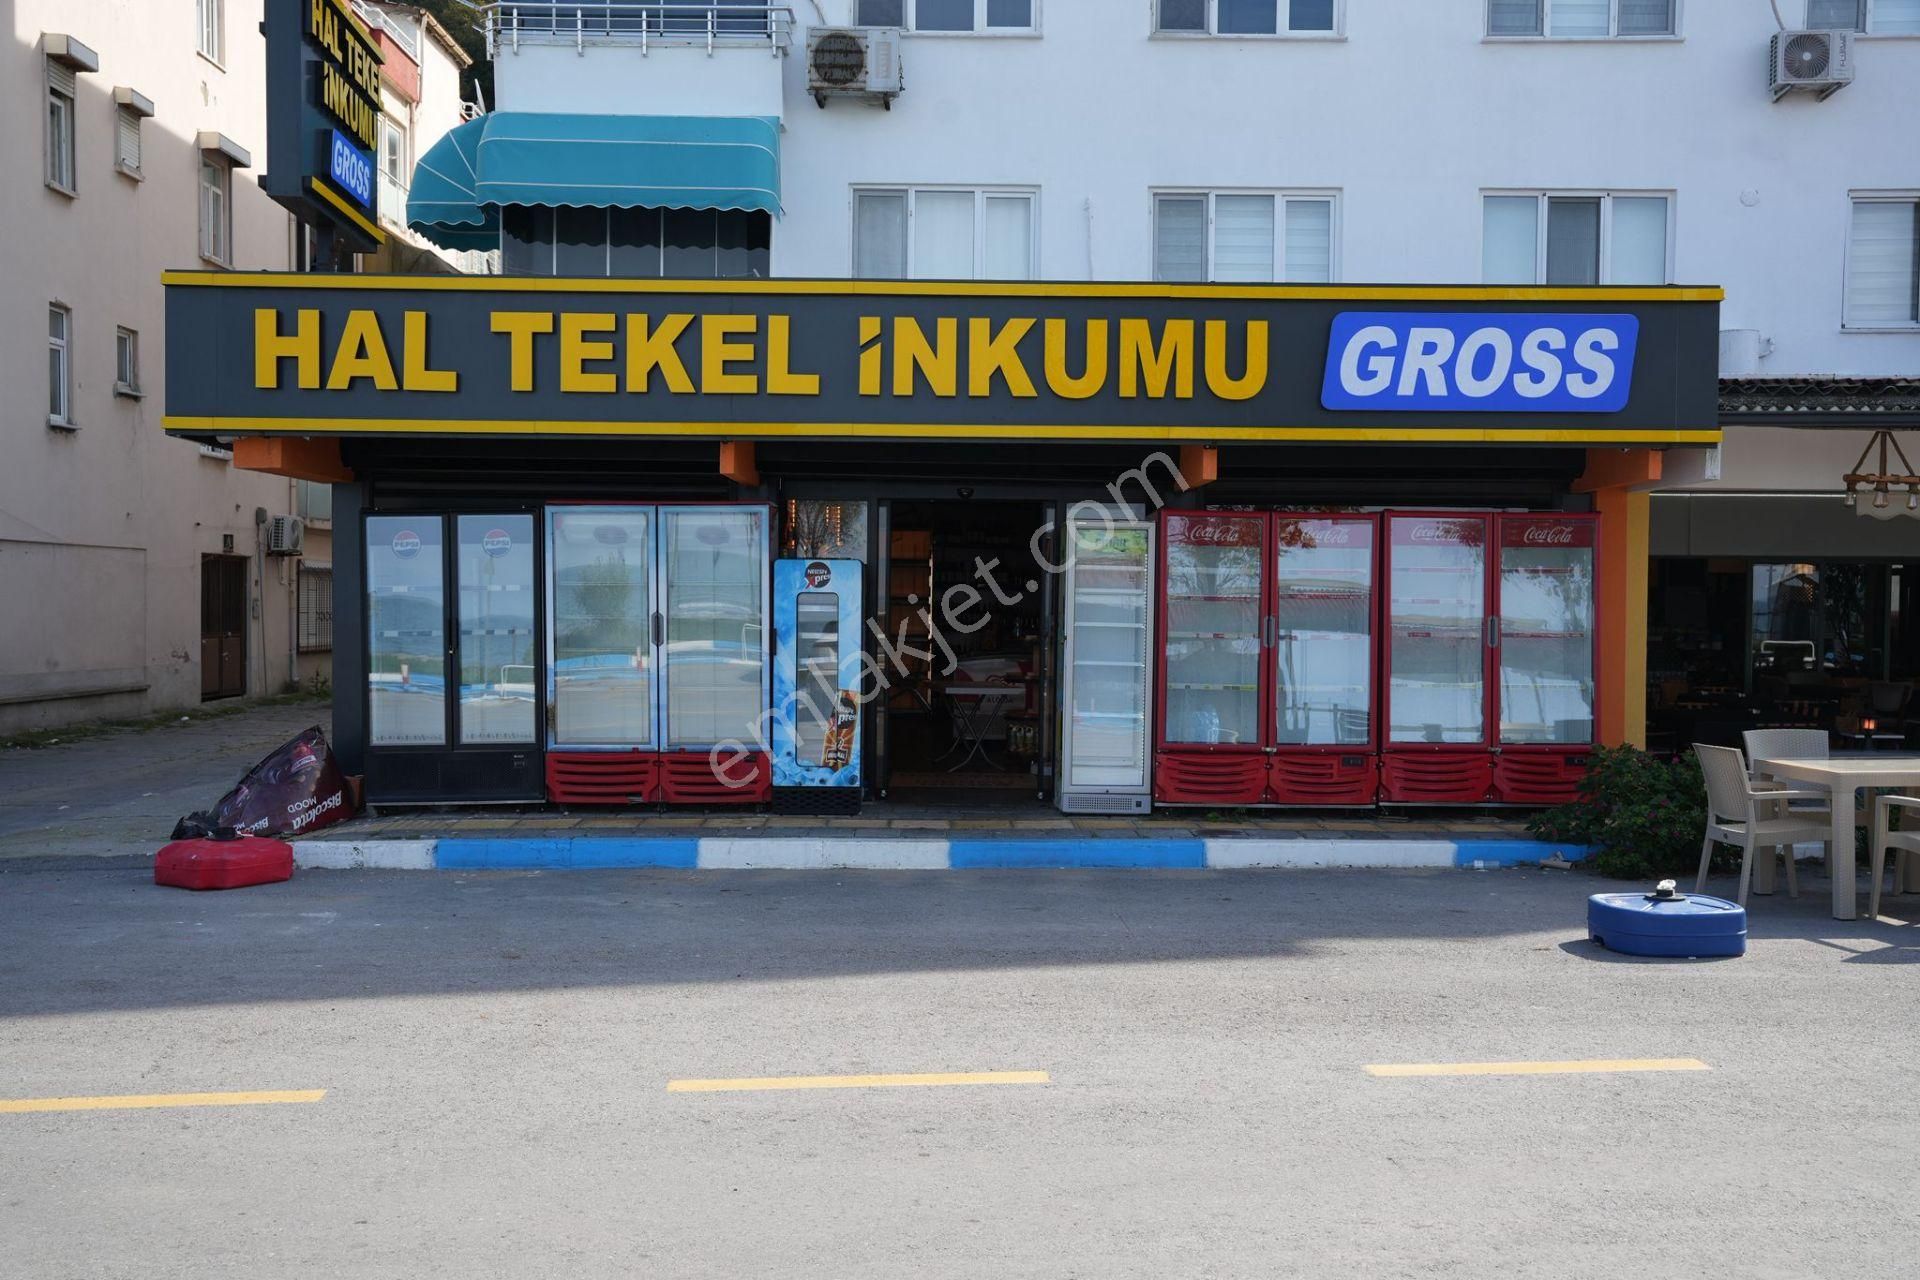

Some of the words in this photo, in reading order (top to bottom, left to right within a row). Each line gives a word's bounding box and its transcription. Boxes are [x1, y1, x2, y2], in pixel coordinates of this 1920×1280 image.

[312, 0, 343, 64] HAL
[345, 29, 383, 111] TEKEL
[334, 139, 371, 200] GROSS
[254, 308, 458, 392] HAL
[490, 312, 820, 395] TEKEL
[1338, 325, 1620, 399] GROSS
[287, 796, 317, 814] MOOD
[292, 789, 342, 831] Biscolata
